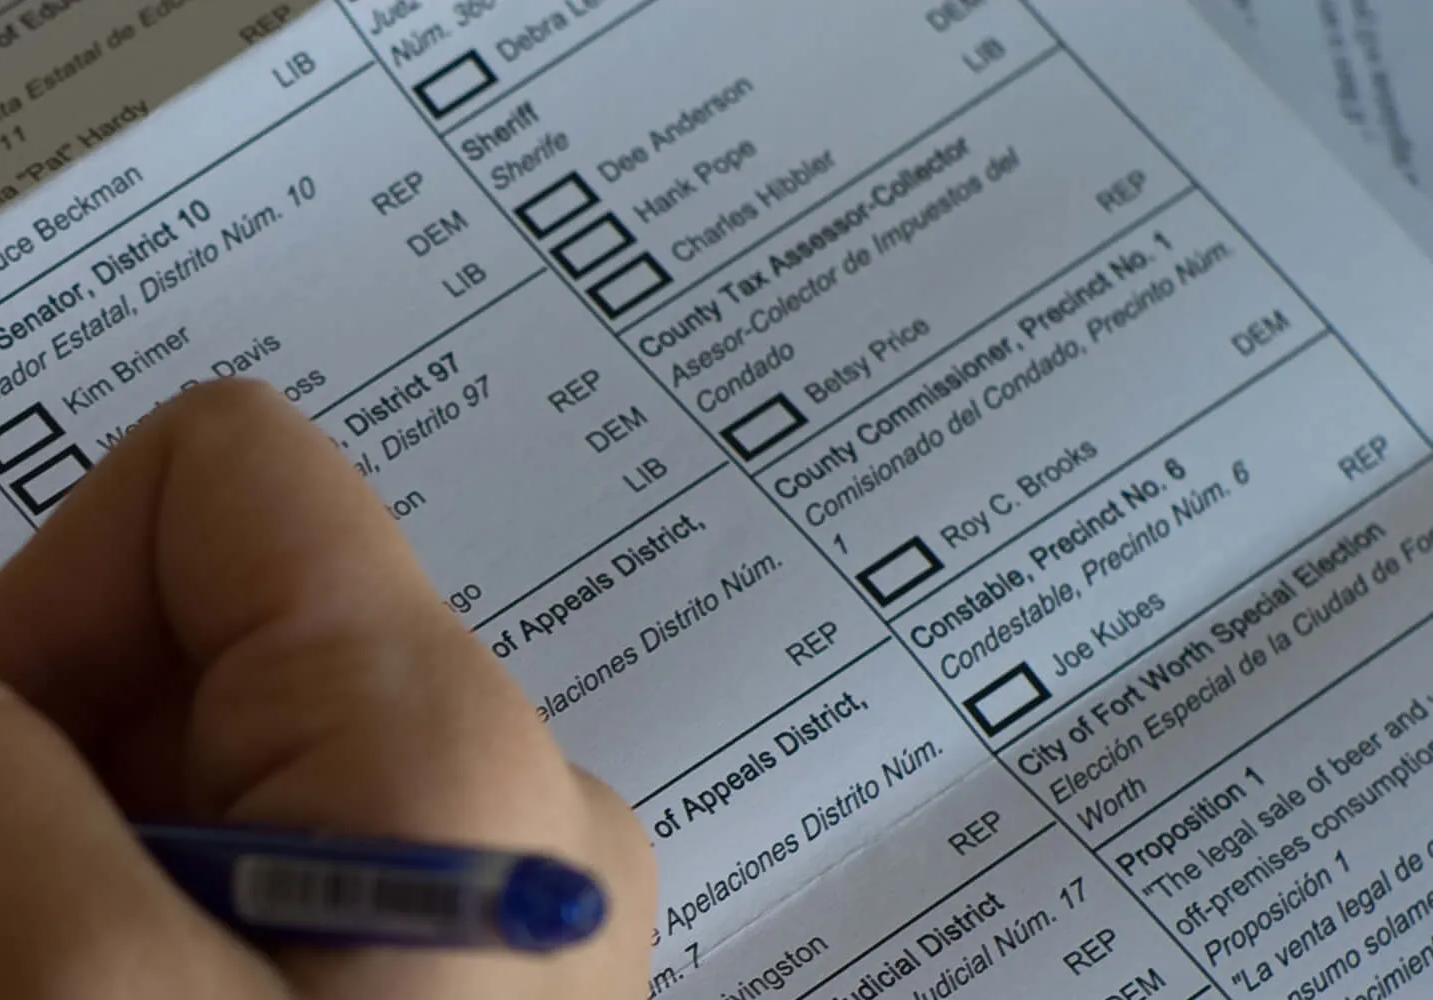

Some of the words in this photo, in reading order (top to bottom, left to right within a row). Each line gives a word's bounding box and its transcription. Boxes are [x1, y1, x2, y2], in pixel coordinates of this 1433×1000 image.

[32, 167, 144, 242] Beckman
[271, 51, 316, 88] LIB
[461, 101, 539, 161] Sheriff
[596, 147, 649, 183] Dee
[649, 78, 753, 152] Anderson
[633, 180, 697, 224] Hank
[693, 141, 757, 185] Pope
[671, 204, 759, 262] Charles
[755, 150, 834, 207] Hibbler
[962, 38, 1005, 72] LIB
[51, 294, 138, 361] Estatal,
[139, 243, 219, 304] Distrito
[221, 206, 283, 251] Núm.
[287, 175, 316, 207] 10
[61, 378, 115, 415] Kim
[110, 326, 190, 384] Brimer
[371, 171, 423, 216] REP
[90, 221, 179, 286] District
[177, 199, 211, 229] 10
[211, 335, 281, 377] Davis
[406, 209, 469, 258] DEM
[441, 262, 487, 298] LIB
[803, 356, 871, 404] Betsy
[867, 319, 930, 362] Price
[1096, 170, 1146, 212] REP
[343, 374, 432, 437] District
[427, 351, 459, 382] 97
[774, 441, 858, 499] County
[856, 337, 1024, 445] Commissioner,
[1017, 272, 1113, 340] Precinct
[1108, 250, 1156, 282] No.
[1153, 231, 1172, 250] 1
[939, 510, 991, 549] Roy
[988, 493, 1020, 516] C.
[1015, 441, 1098, 499] Brooks
[1230, 310, 1290, 357] DEM
[910, 569, 1035, 649] Constable,
[1028, 499, 1126, 571] Precinct
[1120, 480, 1168, 510] No.
[1164, 457, 1187, 481] 6
[1052, 642, 1094, 677] Joe
[1090, 593, 1166, 648] Kubes
[1337, 436, 1387, 480] REP
[784, 621, 838, 667] REP
[1017, 738, 1068, 776] City
[1068, 715, 1095, 744] of
[1090, 685, 1146, 727] Fort
[1139, 640, 1215, 692] Worth
[1210, 579, 1297, 644] Special
[1291, 523, 1386, 589] Election
[654, 807, 681, 839] of
[682, 751, 777, 823] Appeals
[772, 691, 869, 757] District,
[1076, 778, 1147, 831] Worth
[1115, 783, 1247, 877] Proposition
[1244, 766, 1265, 786] 1
[1141, 863, 1202, 898] "The
[1196, 818, 1258, 868] legal
[1257, 789, 1306, 828] sale
[1306, 764, 1333, 793] of
[1327, 733, 1382, 776] beer
[1384, 698, 1429, 739] and
[947, 810, 1001, 856] REP
[1175, 835, 1311, 936] off-premises
[916, 892, 1006, 958] District
[1062, 928, 1116, 976] REP
